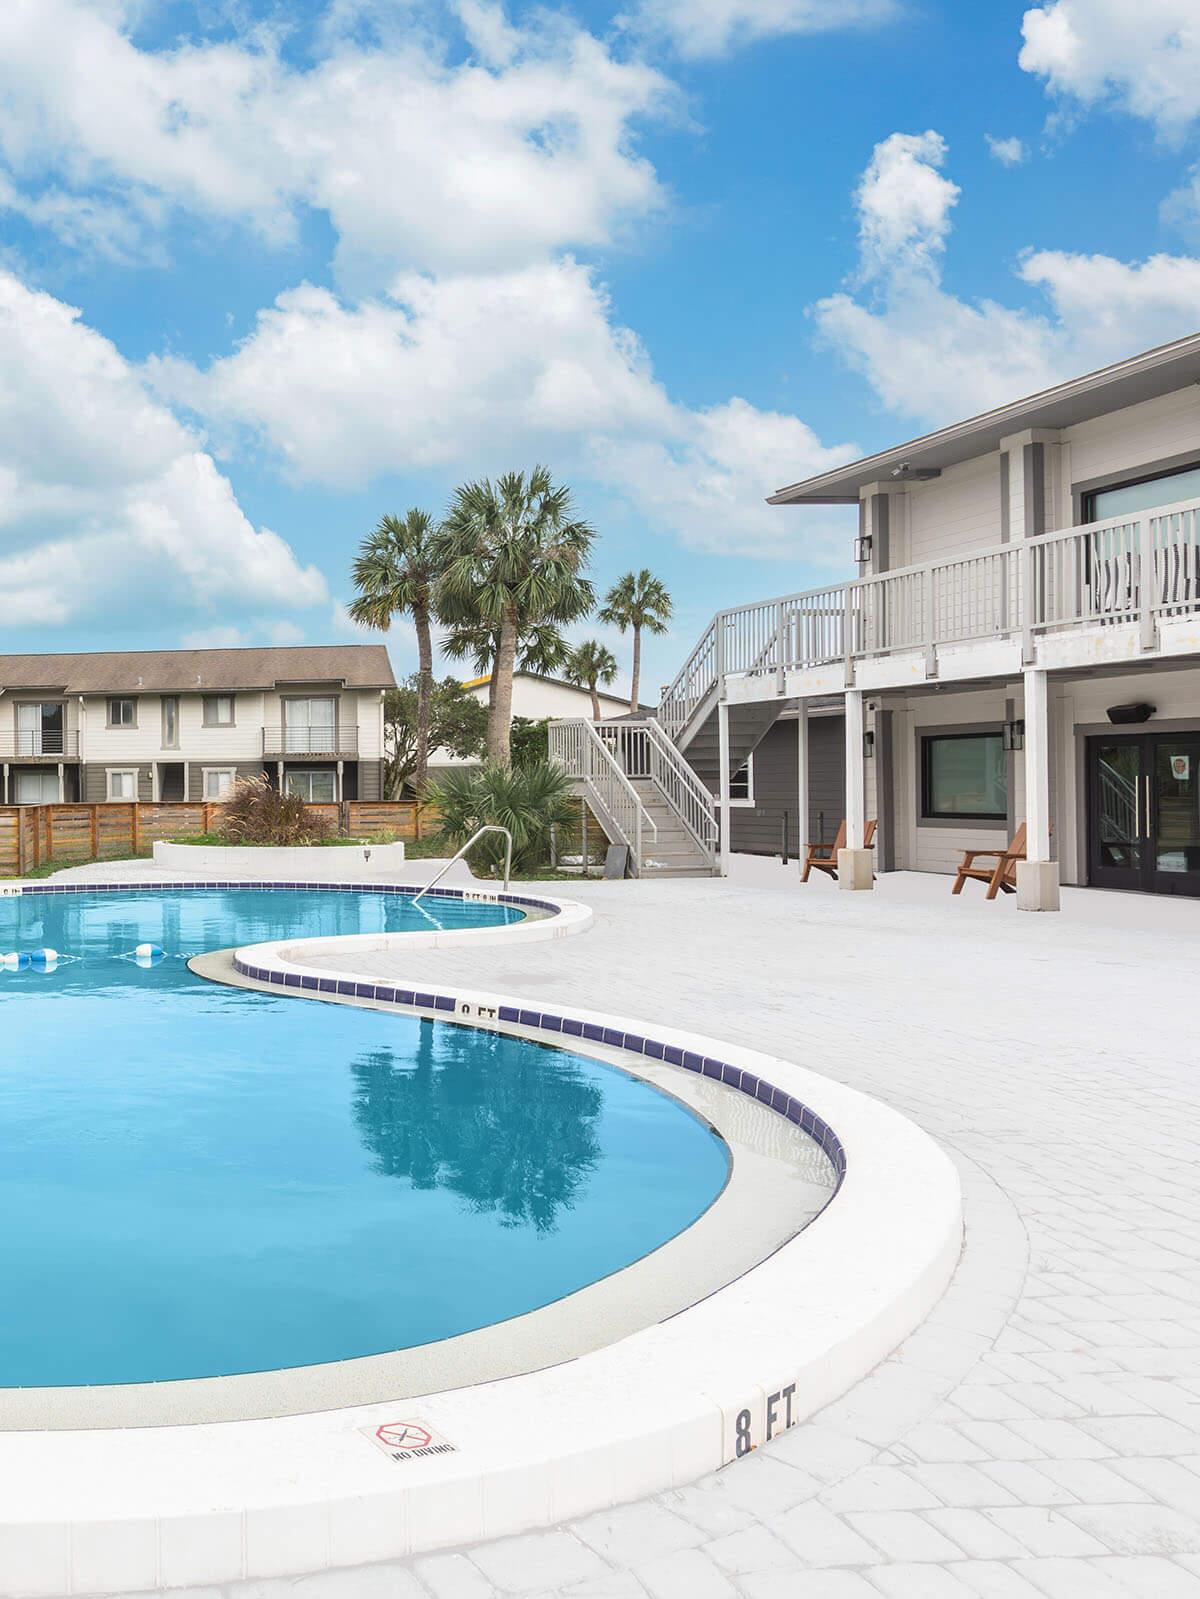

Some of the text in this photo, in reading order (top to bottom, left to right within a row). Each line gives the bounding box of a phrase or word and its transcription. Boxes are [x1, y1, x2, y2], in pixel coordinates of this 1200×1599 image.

[736, 1408, 751, 1458] 8
[391, 1444, 456, 1462] NO DIVING
